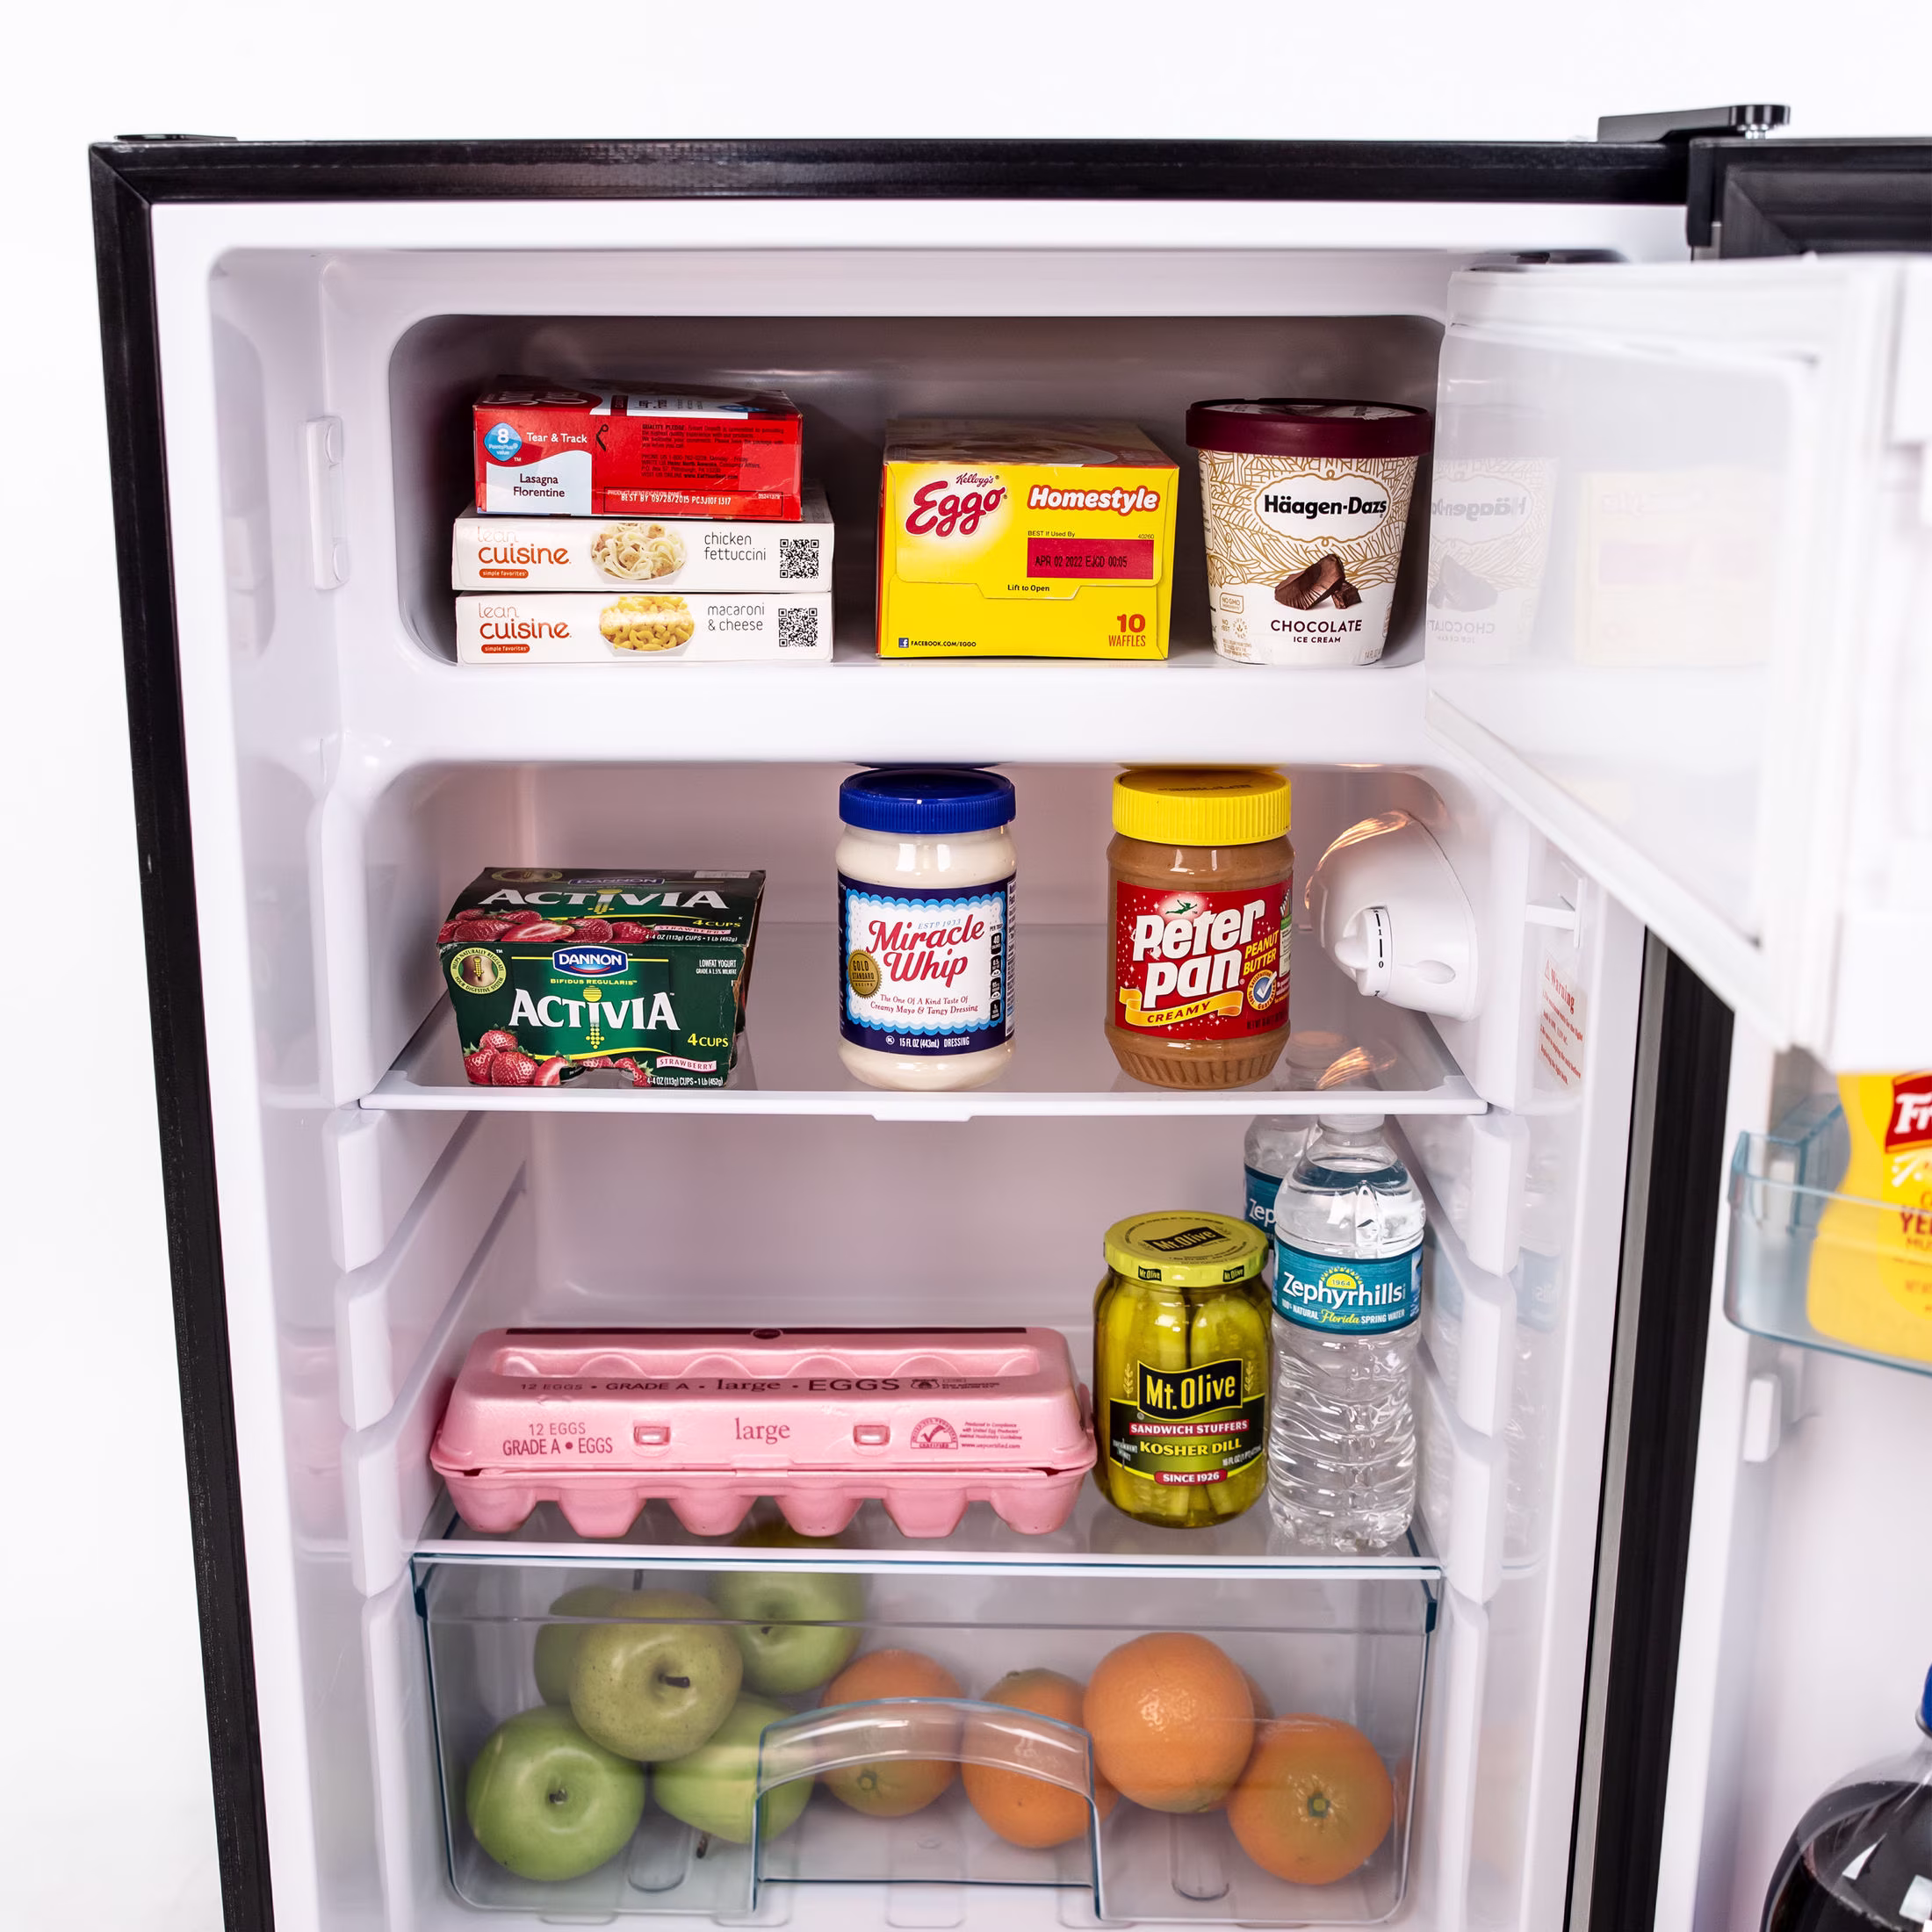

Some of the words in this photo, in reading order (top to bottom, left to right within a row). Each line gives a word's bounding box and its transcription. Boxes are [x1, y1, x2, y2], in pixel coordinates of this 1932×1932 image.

[497, 428, 509, 443] 8
[526, 432, 548, 443] Tear
[551, 433, 559, 443] &
[560, 433, 588, 443] Track
[520, 473, 559, 486] Lasagna
[955, 472, 994, 487] Kellogg's
[513, 487, 565, 497] Florentine
[651, 495, 689, 504] 09/28/2015
[1028, 486, 1159, 515] Homestyle
[1264, 494, 1387, 519] Häagen-Dazs
[905, 480, 1006, 537] Eggo
[478, 526, 519, 543] lean
[704, 531, 752, 544] chicken
[479, 543, 570, 565] cuisine
[704, 546, 766, 560] fettuccini
[1034, 555, 1052, 567] APR
[1054, 556, 1063, 567] 02
[1065, 556, 1083, 567] 2022
[479, 602, 519, 618] lean
[708, 602, 764, 616] macaroni
[479, 618, 570, 639] cuisine
[708, 618, 716, 631] &
[719, 618, 763, 631] cheese
[1117, 614, 1145, 632] 10
[1271, 619, 1363, 633] CHOCOLATE
[1108, 634, 1146, 646] WAFFLES
[478, 889, 730, 910] ACTIVIA
[865, 914, 984, 954] Miracle
[1132, 899, 1265, 962] Peter
[1244, 929, 1280, 959] PEANUT
[559, 954, 622, 966] DANNON
[699, 959, 717, 968] LOWFAT
[717, 959, 737, 968] YOGURT
[852, 960, 869, 971] GOLD
[1243, 948, 1277, 976] BUTTER
[883, 948, 968, 988] Whip
[881, 993, 890, 1002] The
[960, 995, 969, 1004] Of
[1551, 969, 1575, 1014] Warning
[508, 985, 681, 1031] ACTIVIA
[870, 1000, 894, 1013] Creamy
[896, 1005, 915, 1015] Mayo
[926, 1006, 948, 1015] Tangy
[949, 1005, 978, 1014] Dressing
[1147, 1001, 1211, 1023] CREAMY
[687, 1033, 698, 1046] 4
[699, 1036, 729, 1048] CUPS
[899, 1037, 905, 1047] 15
[906, 1038, 912, 1048] FL
[912, 1038, 919, 1048] OZ
[943, 1036, 970, 1048] DRESSING
[660, 1058, 713, 1070] STRAWBERRY
[664, 1077, 679, 1086] (113g)
[679, 1077, 694, 1085] CUPS
[708, 1076, 724, 1086] (452g)
[1282, 1271, 1403, 1309] Zephyrhills
[1293, 1304, 1319, 1319] NATURAL
[1320, 1308, 1360, 1324] Florida
[1361, 1314, 1387, 1324] SPRING
[1388, 1308, 1405, 1321] WATER
[717, 1379, 782, 1392] large
[808, 1379, 900, 1391] EGGS
[1147, 1373, 1178, 1409] Mt.
[1181, 1373, 1236, 1409] Olive
[529, 1424, 544, 1436] 12
[549, 1422, 586, 1435] EGGS
[735, 1417, 790, 1445] large
[1130, 1424, 1193, 1435] SANDWICH
[1196, 1420, 1248, 1434] STUFFERS
[502, 1438, 547, 1456] GRADE
[551, 1438, 561, 1454] A
[578, 1437, 613, 1454] EGGS
[1140, 1441, 1208, 1457] KOSHER
[1212, 1438, 1242, 1454] DILL
[1163, 1473, 1194, 1482] SINCE
[1197, 1471, 1220, 1481] 1926
